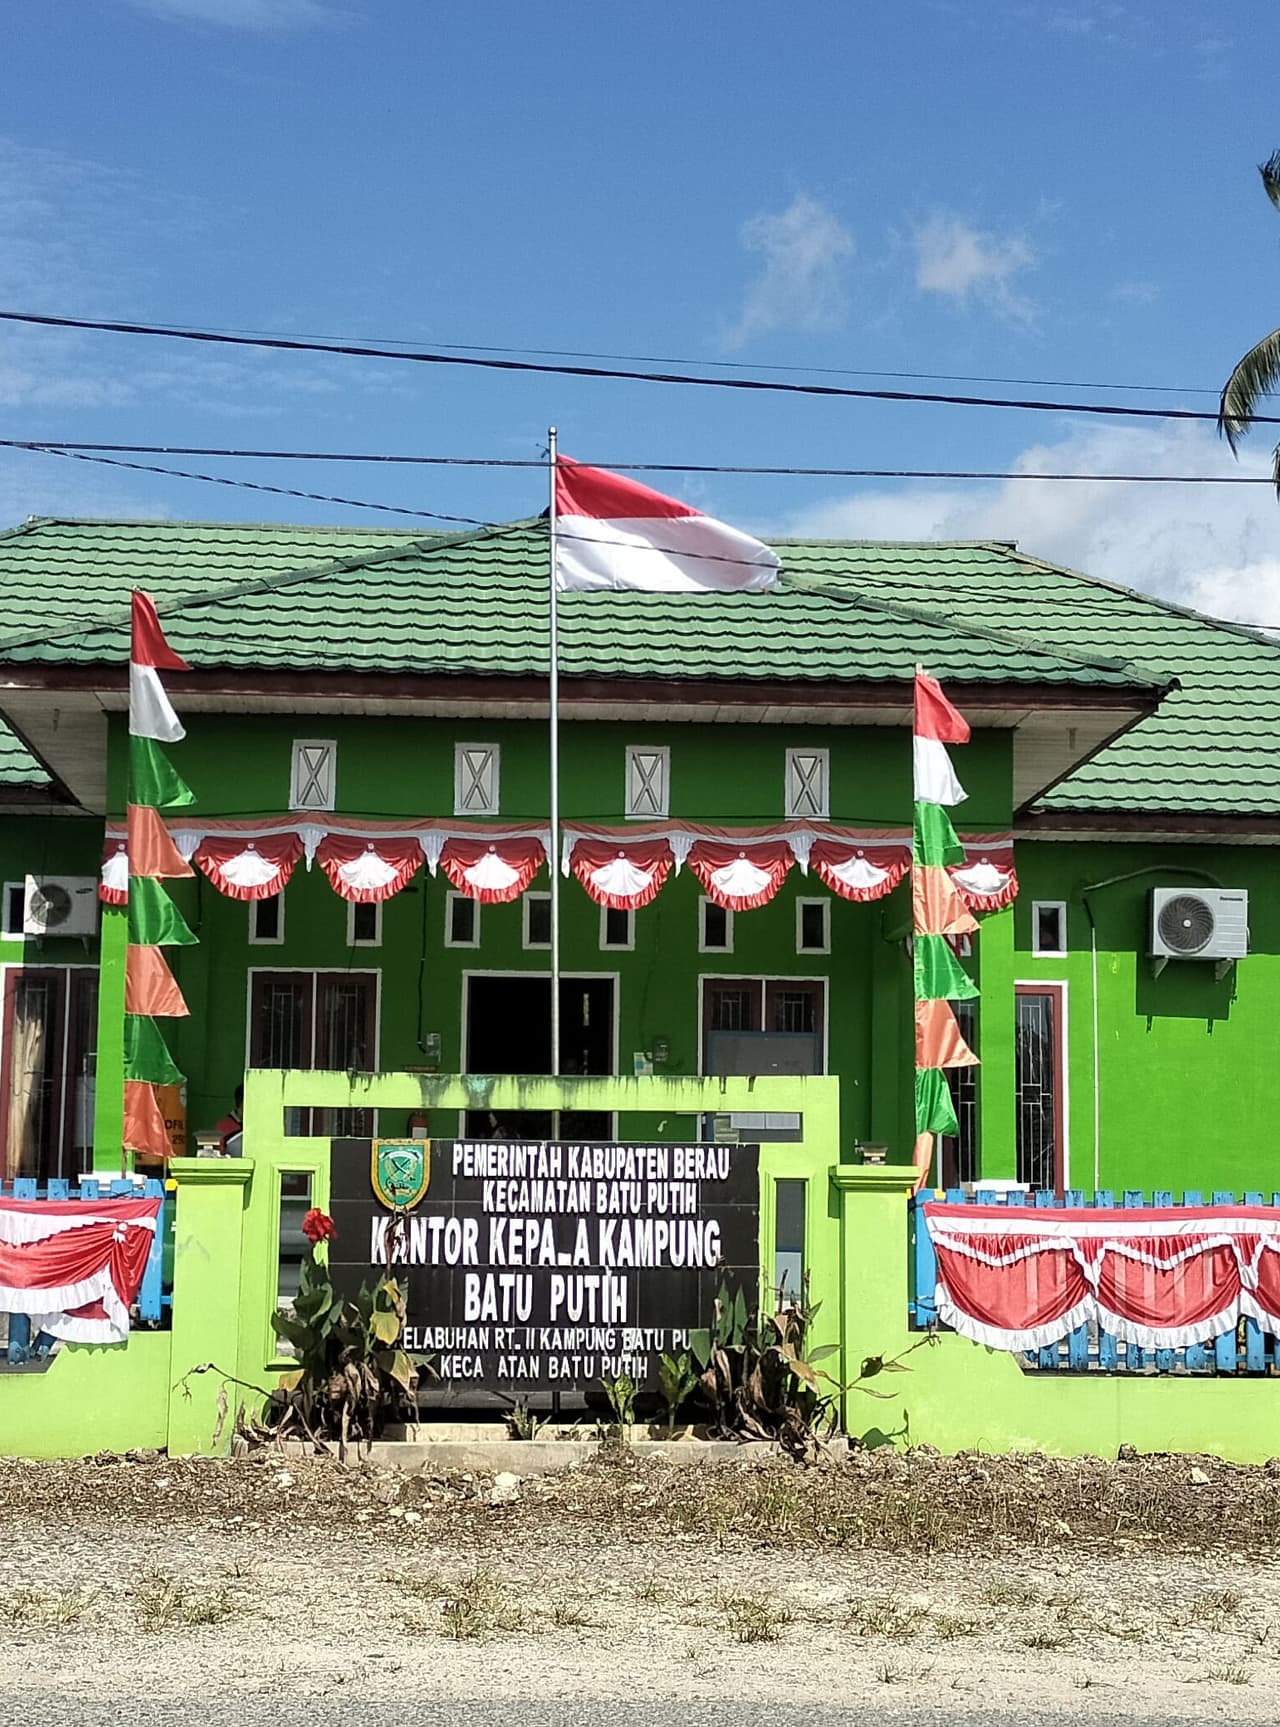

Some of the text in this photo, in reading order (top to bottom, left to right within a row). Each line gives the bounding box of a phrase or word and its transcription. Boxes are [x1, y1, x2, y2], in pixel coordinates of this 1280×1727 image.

[452, 1143, 730, 1180] PEMERINTAH KABUPATEN BERAU
[483, 1180, 697, 1215] KECAMATAN BATU PUTIH
[370, 1216, 479, 1266] KANTOR
[599, 1218, 721, 1268] KAMPUNG
[464, 1273, 627, 1323] BATU PUTIH
[403, 1326, 490, 1350] ELABUHAN
[494, 1327, 521, 1350] RT.
[539, 1327, 616, 1351] KAMPUNG
[622, 1328, 664, 1351] BATU
[548, 1355, 594, 1379] BATU
[601, 1355, 648, 1379] PUTIH
